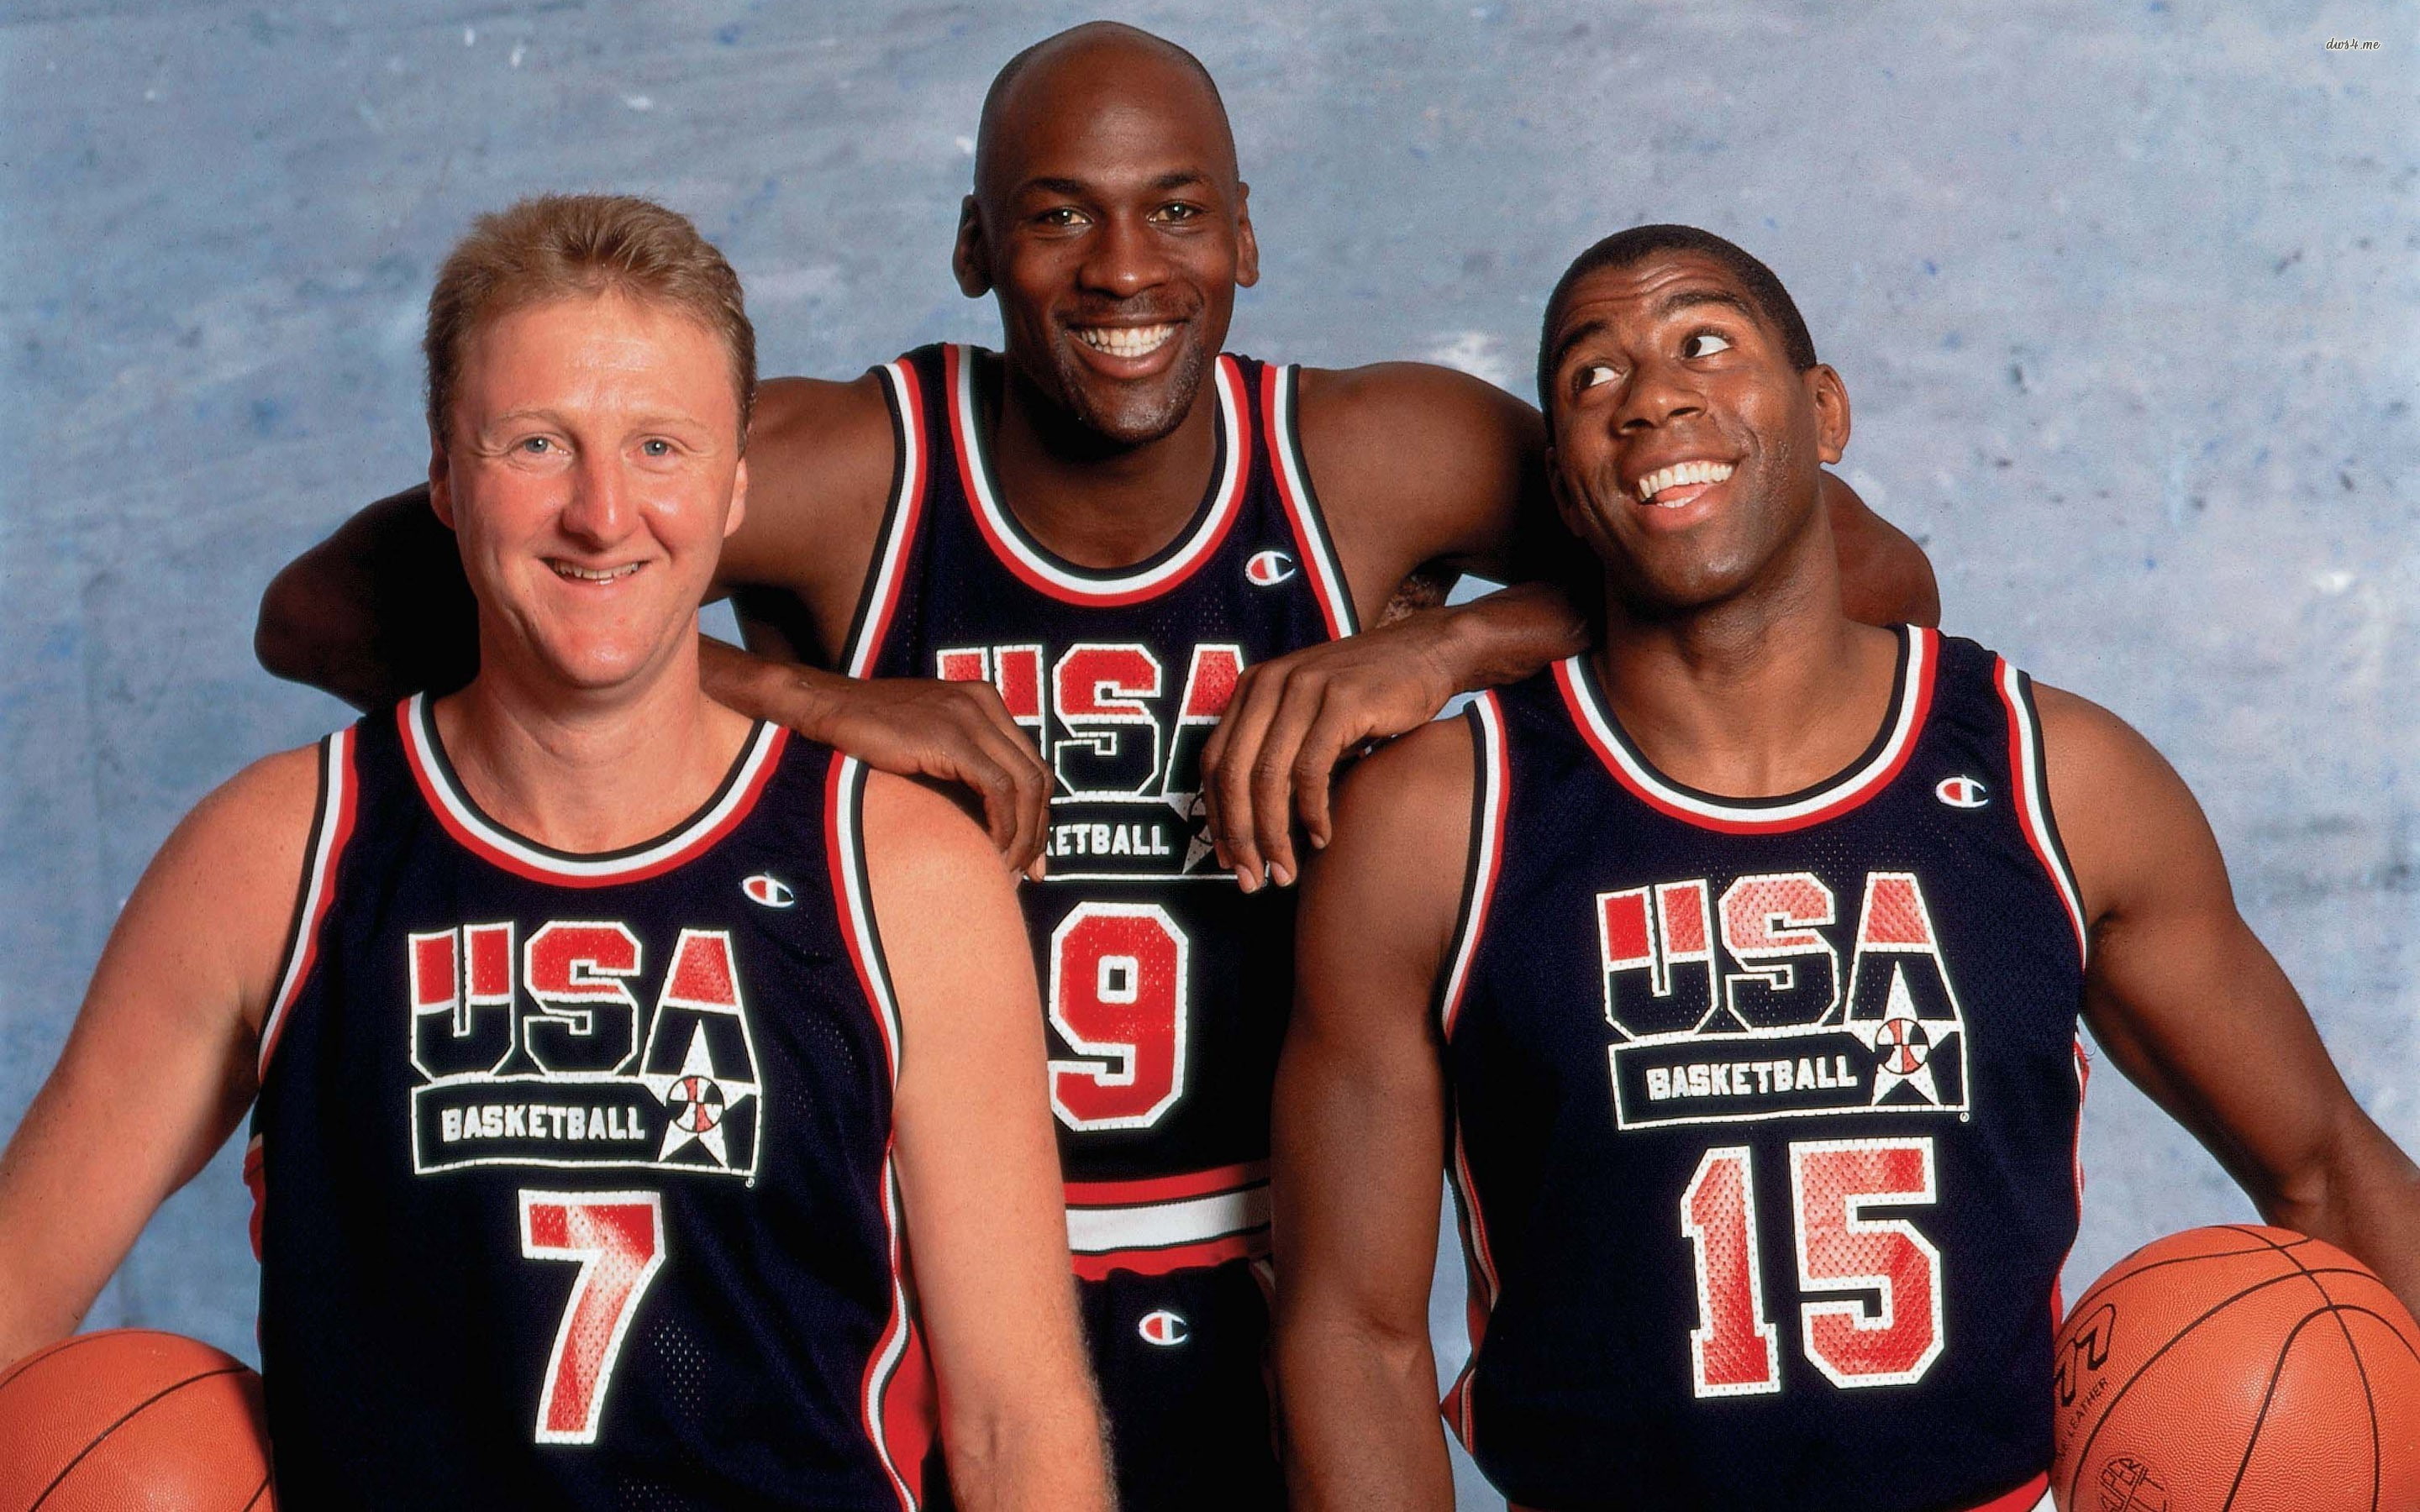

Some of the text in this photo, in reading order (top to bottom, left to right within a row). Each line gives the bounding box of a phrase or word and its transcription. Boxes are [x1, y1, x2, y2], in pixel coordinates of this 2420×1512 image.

[408, 921, 762, 1084] USA
[1047, 901, 1189, 1131] 9
[1597, 872, 1965, 1043] USA
[441, 1105, 646, 1143] BASKETBALL
[1645, 1055, 1858, 1101] BASKETBALL
[518, 1189, 666, 1444] 7
[1680, 1137, 1944, 1398] 15
[2067, 1377, 2108, 1437] LEATHER
